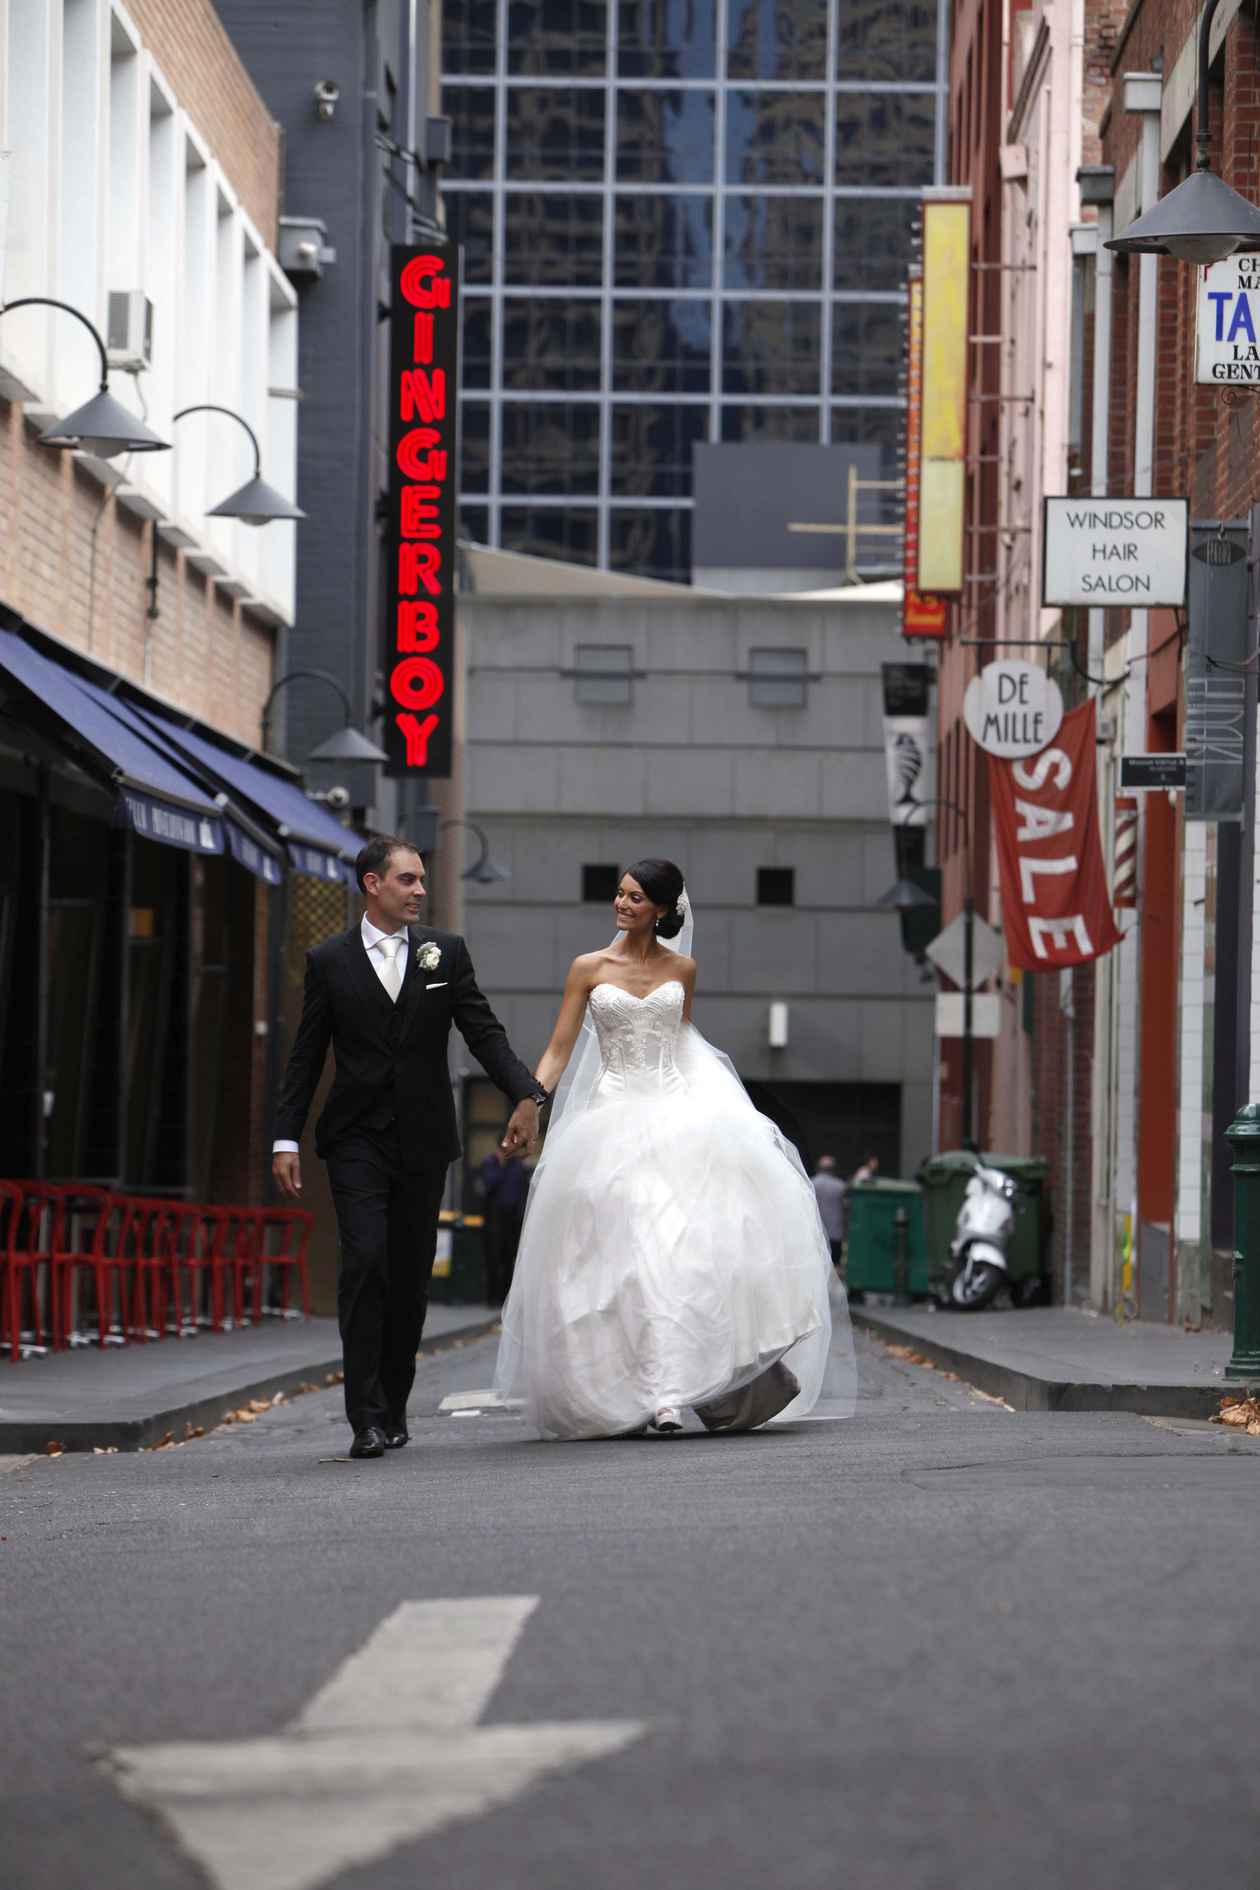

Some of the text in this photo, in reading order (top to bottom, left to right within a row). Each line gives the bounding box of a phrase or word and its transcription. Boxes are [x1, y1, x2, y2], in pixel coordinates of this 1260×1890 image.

[390, 254, 450, 767] GINGERBOY
[1066, 511, 1166, 530] WINDSOR
[1091, 543, 1139, 561] HAIR
[1081, 573, 1151, 593] SALON
[998, 673, 1029, 705] DE
[981, 711, 1044, 745] MILLE
[1011, 747, 1095, 960] SALE
